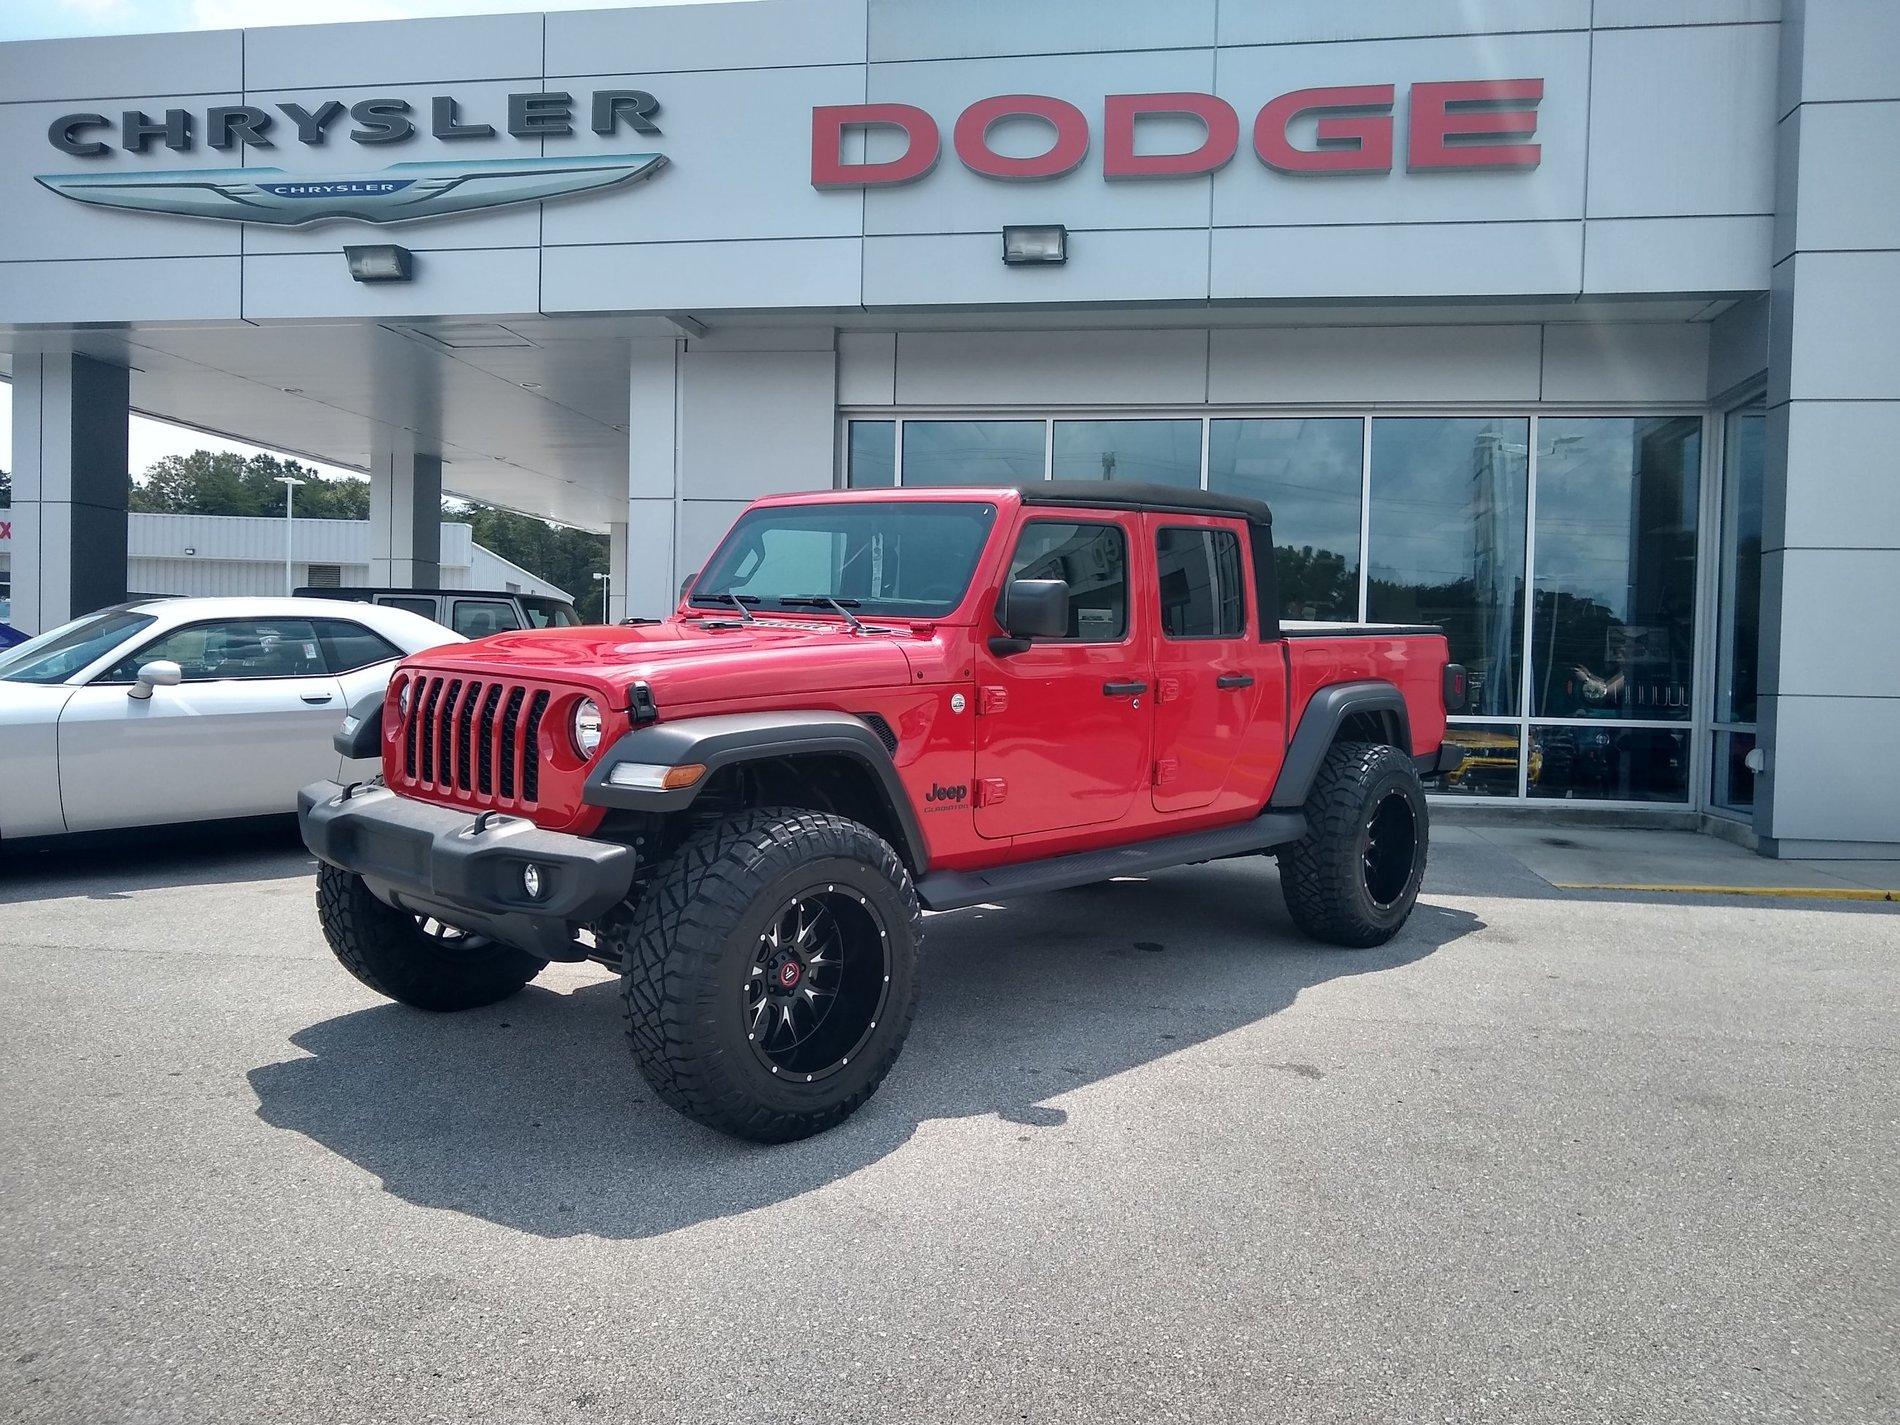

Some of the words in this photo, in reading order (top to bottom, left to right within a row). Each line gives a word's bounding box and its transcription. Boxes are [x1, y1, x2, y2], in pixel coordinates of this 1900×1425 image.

[48, 89, 663, 157] CHRYSLER
[811, 78, 1545, 191] DODGE
[274, 184, 394, 194] CHRYSLER
[925, 782, 968, 803] Jeep
